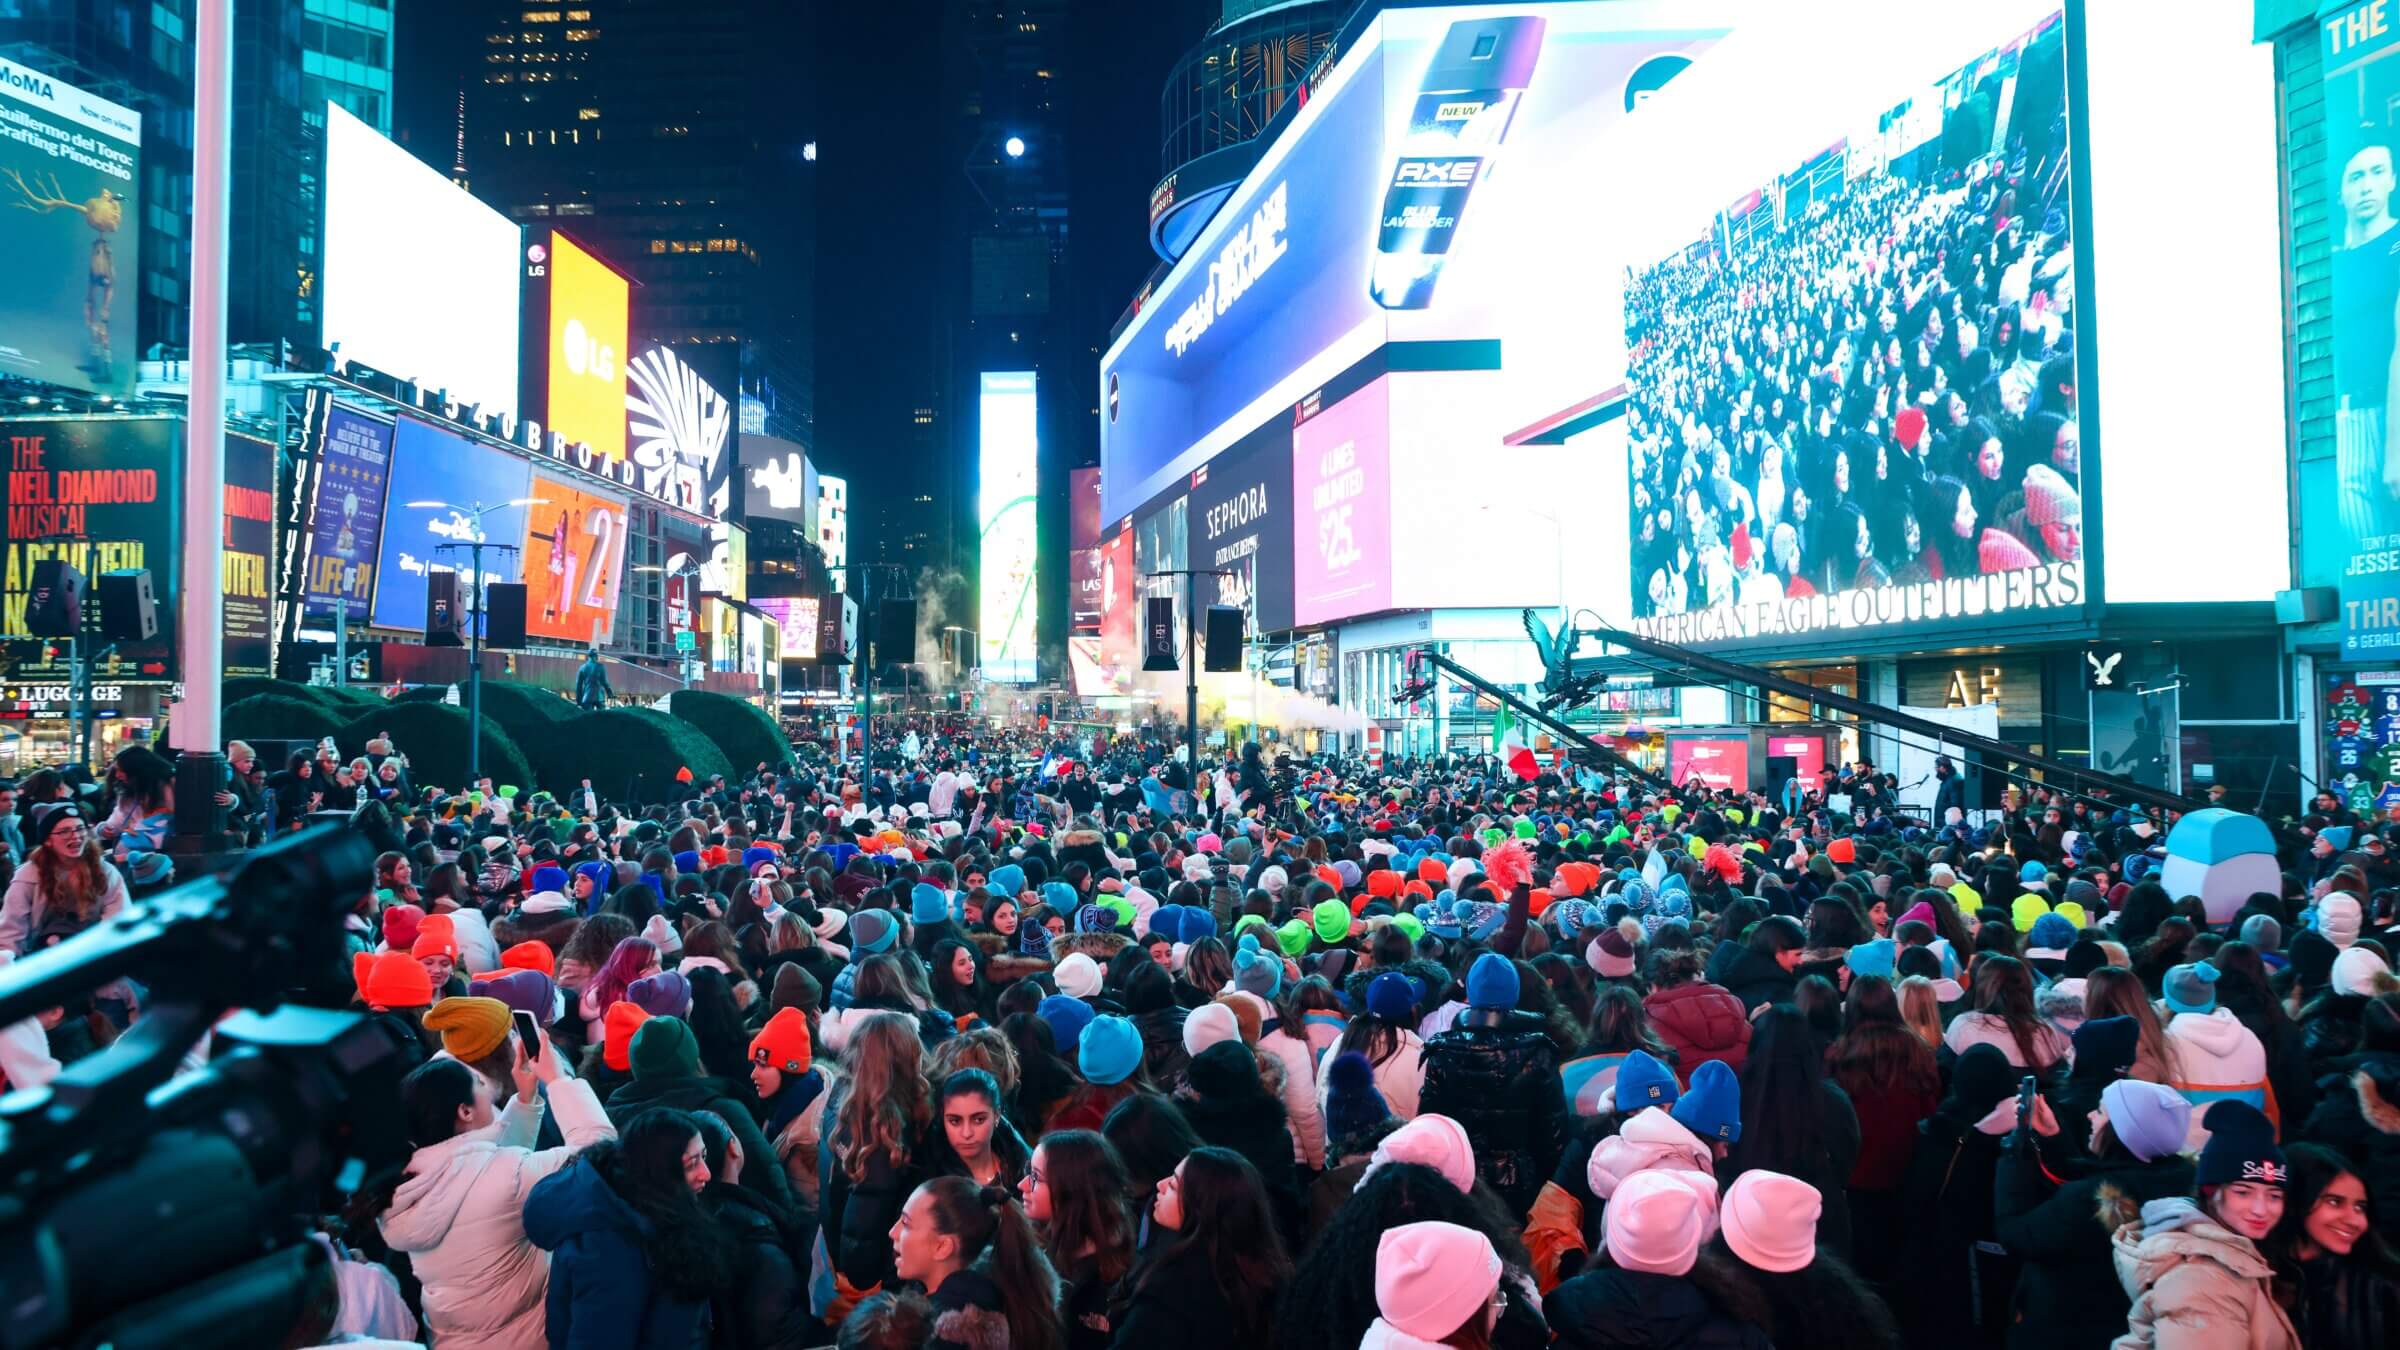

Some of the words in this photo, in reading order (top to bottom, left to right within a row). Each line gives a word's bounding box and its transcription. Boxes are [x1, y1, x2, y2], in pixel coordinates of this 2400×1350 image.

[1441, 106, 1478, 118] NEW
[71, 133, 95, 152] del
[60, 143, 132, 181] Pinocchio
[1396, 162, 1478, 181] AXE
[529, 266, 545, 276] LG
[588, 338, 614, 383] LG
[10, 436, 46, 470] THE
[8, 471, 55, 505] NEIL
[57, 468, 158, 504] DIAMOND
[1206, 482, 1267, 540] SEPHORA
[223, 552, 267, 598] UTIFUL
[310, 554, 345, 596] LIFE
[342, 566, 358, 592] OF
[354, 561, 372, 599] PI
[2346, 550, 2400, 576] JESSE
[1756, 592, 1841, 634] EAGLE
